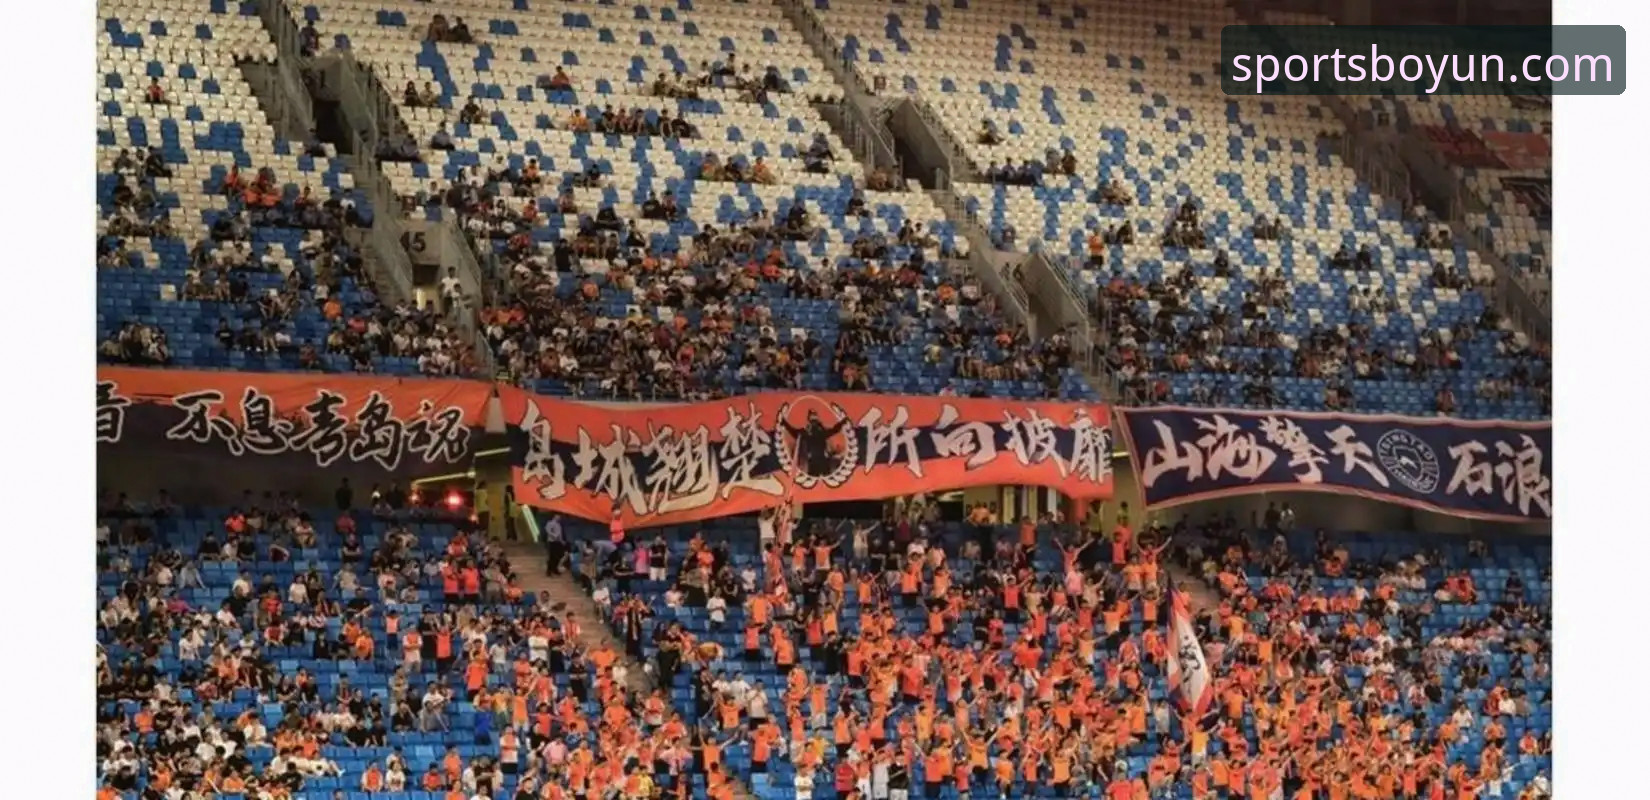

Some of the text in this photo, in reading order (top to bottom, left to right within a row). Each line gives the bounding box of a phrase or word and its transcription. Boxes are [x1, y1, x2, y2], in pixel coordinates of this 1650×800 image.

[859, 404, 1113, 486] 所向披靡
[1142, 413, 1389, 487] 山海擎天
